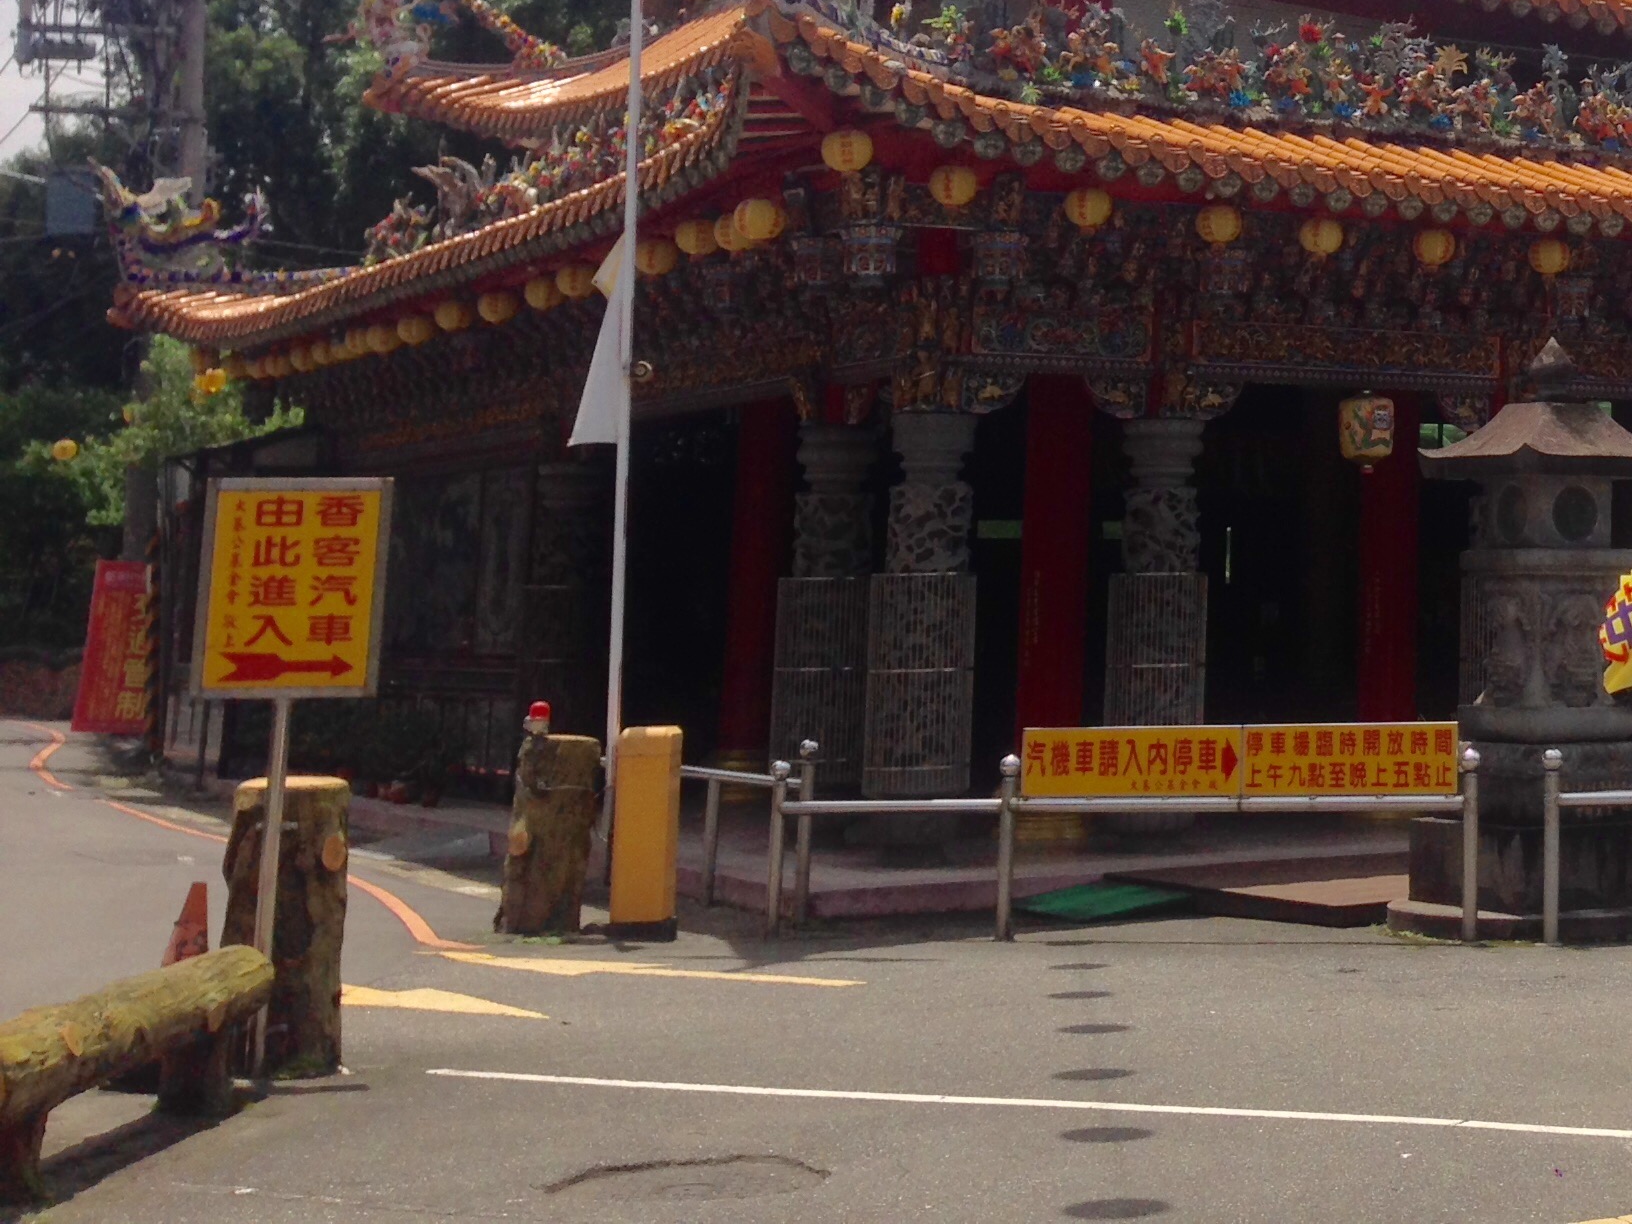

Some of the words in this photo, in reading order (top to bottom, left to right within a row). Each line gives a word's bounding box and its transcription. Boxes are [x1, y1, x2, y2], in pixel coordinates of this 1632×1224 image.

[244, 494, 304, 647] 由此進入
[306, 494, 365, 646] 香客汽車
[1245, 760, 1453, 789] 上午九點至晚上五點止
